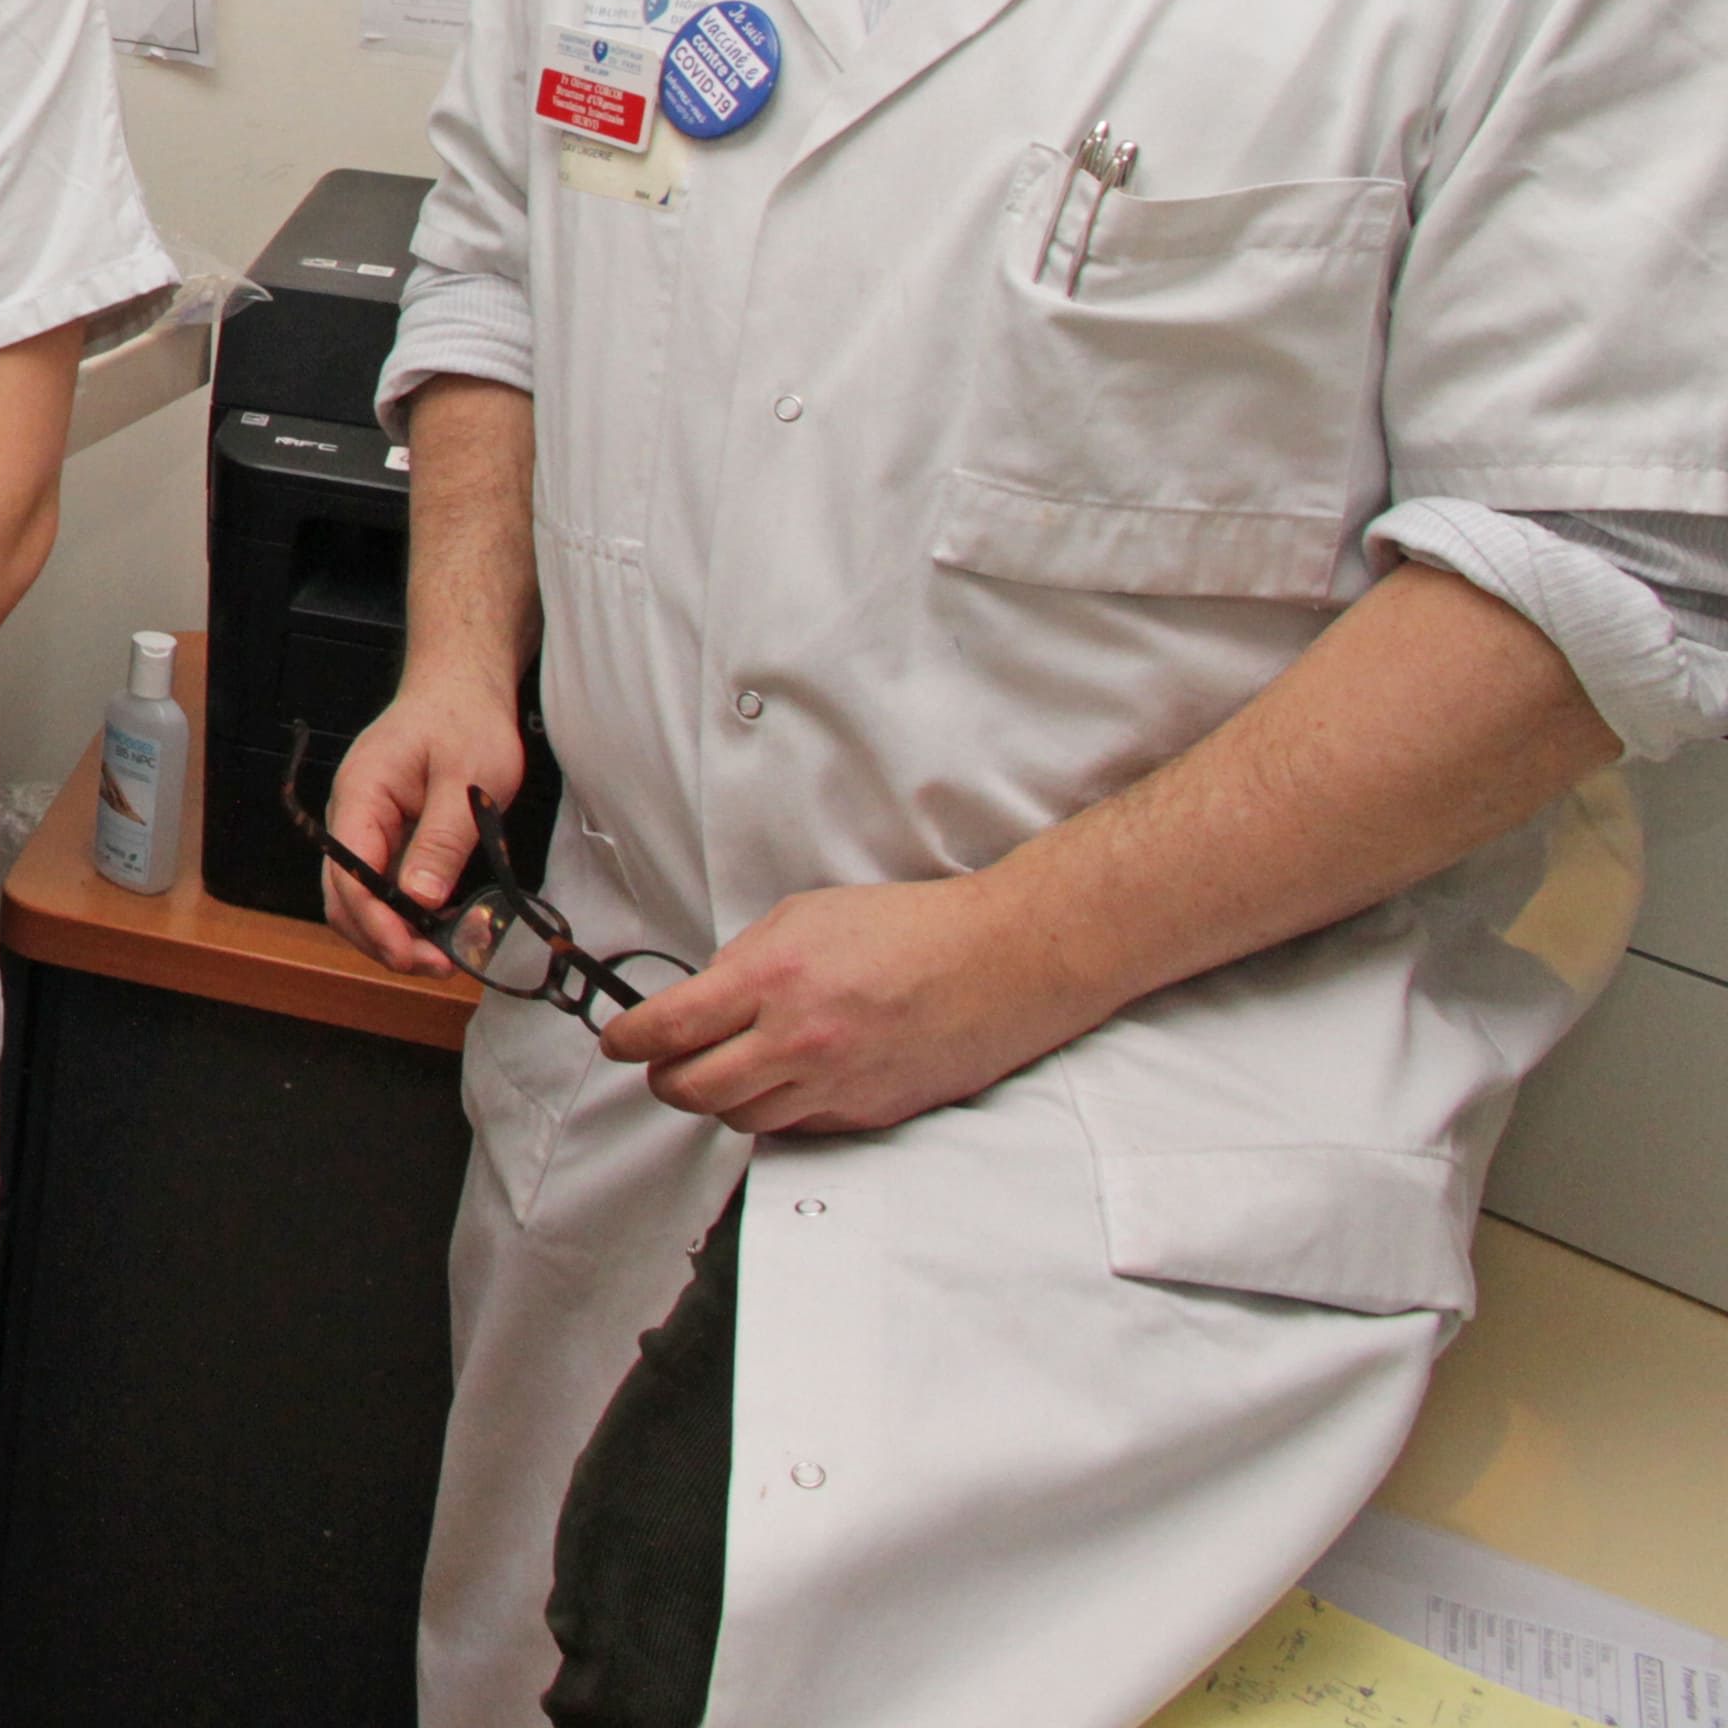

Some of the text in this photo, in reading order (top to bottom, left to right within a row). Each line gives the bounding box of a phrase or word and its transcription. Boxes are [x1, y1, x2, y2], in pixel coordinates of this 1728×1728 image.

[728, 4, 765, 46] Je suis
[675, 46, 731, 113] COVID-19
[692, 34, 740, 91] contre la
